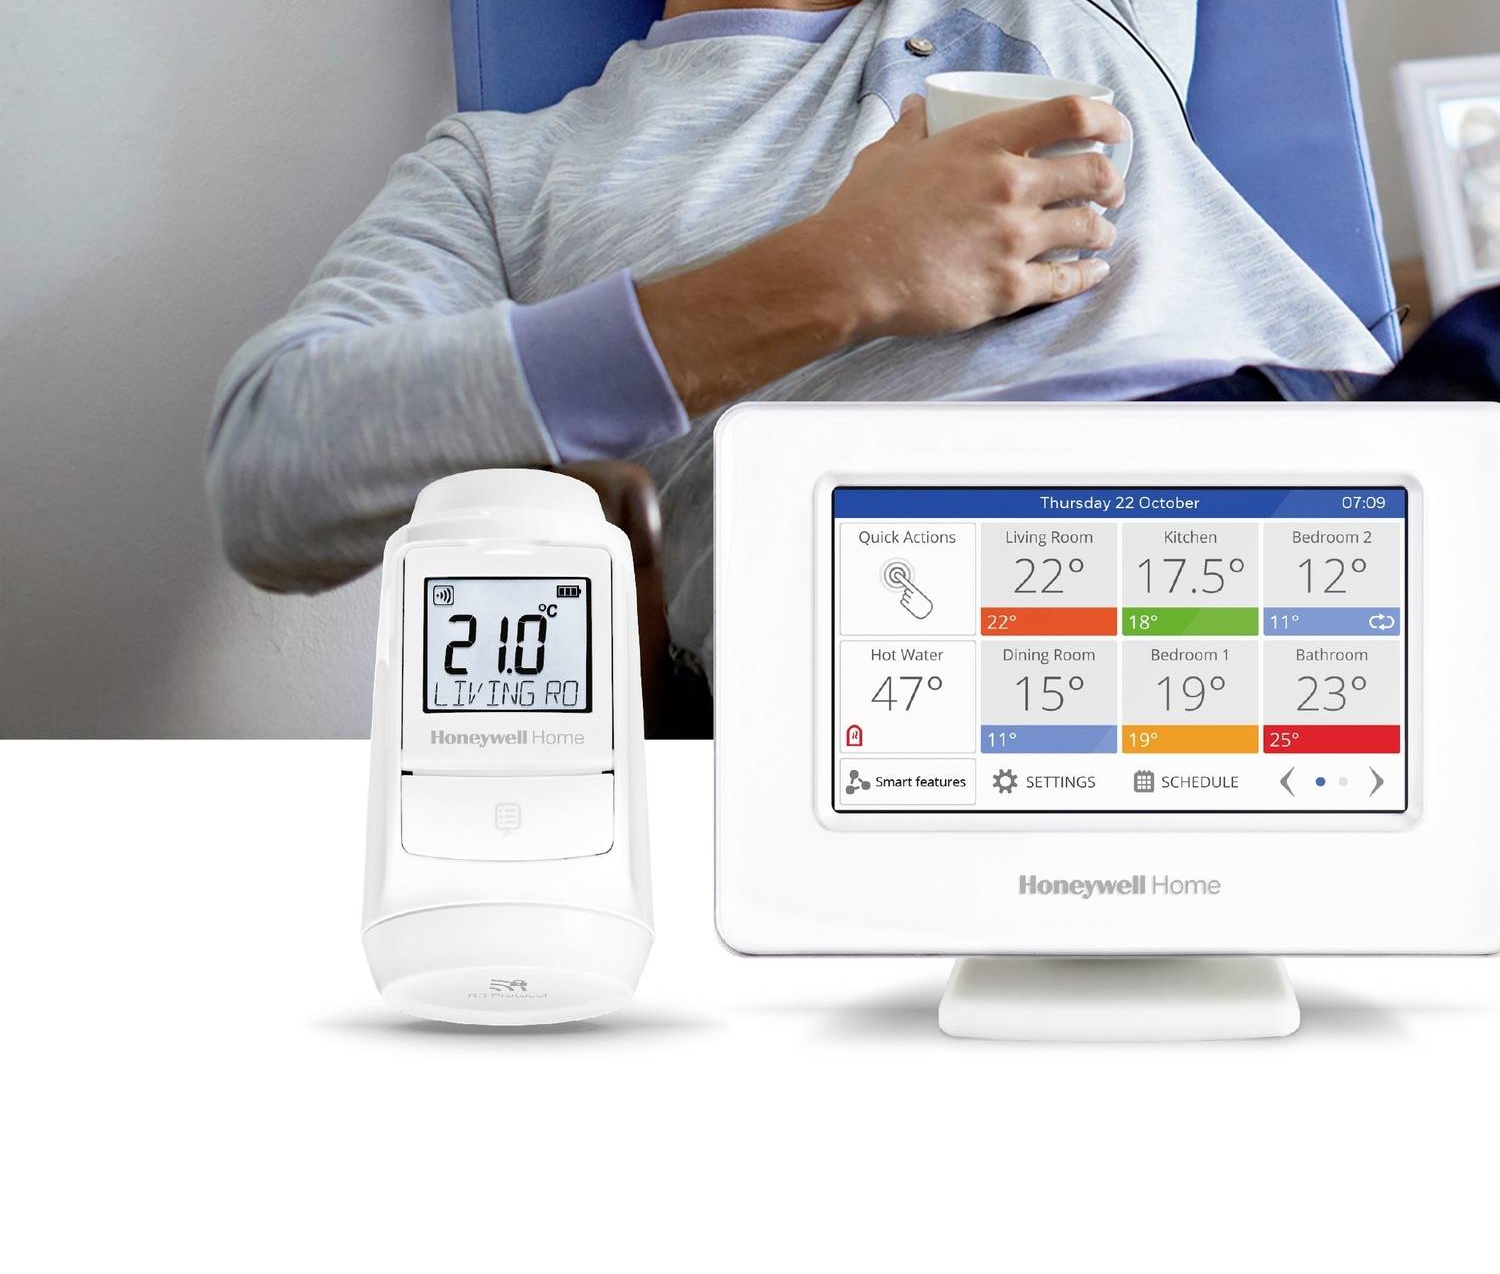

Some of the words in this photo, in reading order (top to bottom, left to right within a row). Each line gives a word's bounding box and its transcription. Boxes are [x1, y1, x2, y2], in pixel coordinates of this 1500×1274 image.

[1039, 496, 1112, 512] Thursday
[1115, 496, 1135, 509] 22
[1138, 496, 1200, 509] October
[1342, 496, 1386, 509] 07:09
[858, 529, 900, 546] Quick
[902, 530, 957, 544] Actions
[1006, 530, 1047, 548] Living
[1051, 530, 1093, 544] Room
[1164, 530, 1217, 544] Kitchen
[1292, 530, 1359, 544] Bedroom
[1363, 530, 1372, 544] 2
[1014, 558, 1084, 594] 22°
[1138, 557, 1245, 594] 17.5°
[1298, 558, 1367, 594] 12°
[987, 614, 1017, 630] 22°
[1129, 614, 1158, 630] 18°
[1270, 614, 1300, 630] 11°
[444, 614, 547, 675] 21.0
[538, 604, 558, 618] °C
[871, 648, 897, 662] Hot
[900, 648, 944, 662] Water
[1003, 648, 1050, 665] Dining
[1054, 648, 1096, 662] Room
[1151, 647, 1218, 662] Bedroom
[1221, 647, 1230, 663] 1
[1296, 647, 1368, 662] Bathroom
[434, 680, 535, 707] LIVING
[545, 680, 579, 707] RO
[870, 675, 943, 712] 47°
[1016, 675, 1084, 712] 15°
[1157, 675, 1226, 712] 19°
[1296, 675, 1367, 712] 23°
[430, 730, 528, 748] Honeywell
[532, 730, 585, 745] Home
[987, 732, 1017, 748] 11°
[1129, 732, 1158, 748] 19°
[1269, 732, 1300, 748] 25°
[875, 776, 913, 788] Smart
[914, 775, 967, 788] features
[1026, 775, 1096, 789] SETTINGS
[1161, 775, 1239, 789] SCHEDULE
[1019, 874, 1146, 900] Honeywell
[1152, 874, 1222, 895] Home
